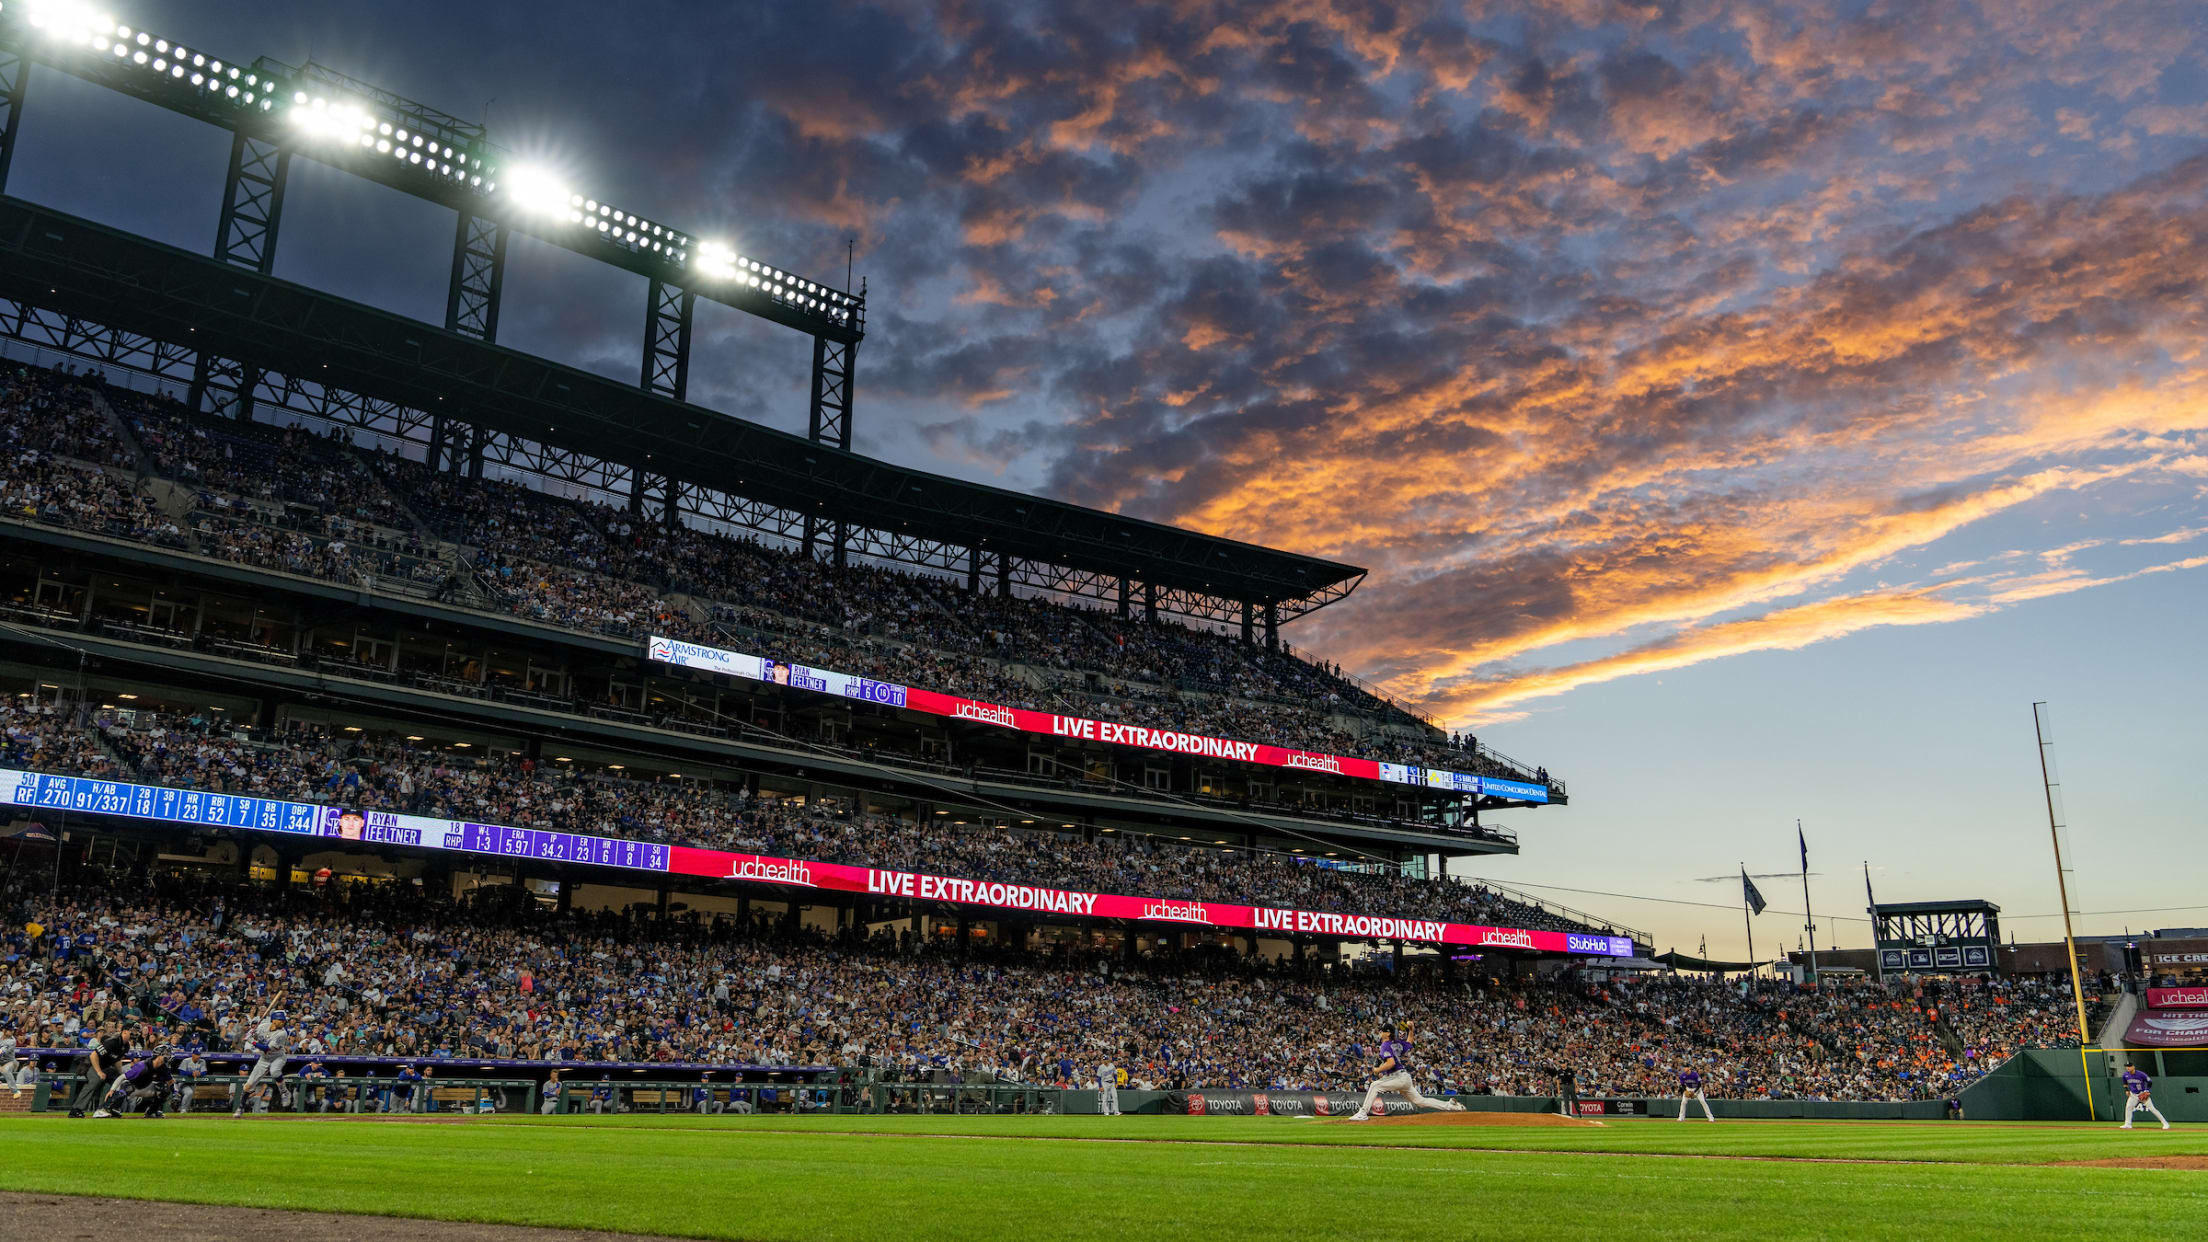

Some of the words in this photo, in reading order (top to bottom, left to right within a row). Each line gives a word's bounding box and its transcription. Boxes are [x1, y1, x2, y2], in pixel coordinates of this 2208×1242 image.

[666, 640, 730, 662] ARMSTRONG
[794, 666, 810, 676] RYAN
[794, 675, 823, 690] FELTNER
[846, 686, 858, 696] RHP
[866, 688, 870, 698] 6
[893, 692, 902, 704] 10
[956, 700, 1014, 726] uchealth
[1053, 716, 1094, 739] LIVE
[1100, 723, 1258, 761] EXTRAORDINARY
[1288, 751, 1339, 772] uchealth
[22, 772, 36, 786] 50
[48, 778, 67, 789] AVG
[18, 788, 34, 802] RF
[92, 783, 116, 794] H/AB
[139, 788, 151, 798] 2B
[1530, 788, 1546, 797] DENTAL
[39, 789, 70, 806] .270
[76, 792, 127, 812] 91/337
[163, 791, 175, 802] 3B
[186, 794, 198, 804] HR
[211, 796, 226, 807] RBI
[136, 800, 150, 814] 18
[164, 802, 170, 816] 1
[183, 804, 198, 819] 23
[240, 800, 250, 810] SB
[265, 802, 276, 812] BB
[292, 805, 308, 816] OBP
[208, 807, 224, 822] 52
[240, 810, 247, 824] 7
[261, 813, 276, 828] 35
[372, 813, 398, 826] RYAN
[284, 816, 310, 832] .344
[450, 822, 460, 834] 18
[370, 826, 417, 844] FELTNER
[478, 826, 490, 836] W-L
[512, 830, 524, 840] ERA
[446, 836, 461, 848] RHP
[476, 836, 491, 850] 1-3
[550, 834, 558, 843] IP
[580, 838, 588, 846] ER
[602, 840, 612, 849] HR
[506, 839, 528, 854] 5.97
[541, 843, 564, 858] 34.2
[626, 843, 635, 852] BB
[652, 845, 660, 854] SO
[576, 847, 589, 860] 23
[602, 850, 609, 862] 6
[626, 852, 633, 866] 8
[650, 855, 662, 868] 34
[733, 856, 810, 883] uchealth
[868, 870, 914, 896] LIVE
[920, 876, 1098, 914] EXTRAORDINARY
[1144, 899, 1207, 922] uchealth
[1254, 908, 1293, 930] LIVE
[1298, 912, 1446, 941] EXTRAORDINARY
[1482, 927, 1532, 948] uchealth
[1570, 936, 1607, 952] StubHub
[1208, 1100, 1242, 1110] TOYOTA
[1272, 1100, 1304, 1110] TOYOTA
[1330, 1101, 1360, 1110] TOYOTA
[1386, 1102, 1414, 1110] TOYOTA
[1578, 1103, 1602, 1112] OYOTA
